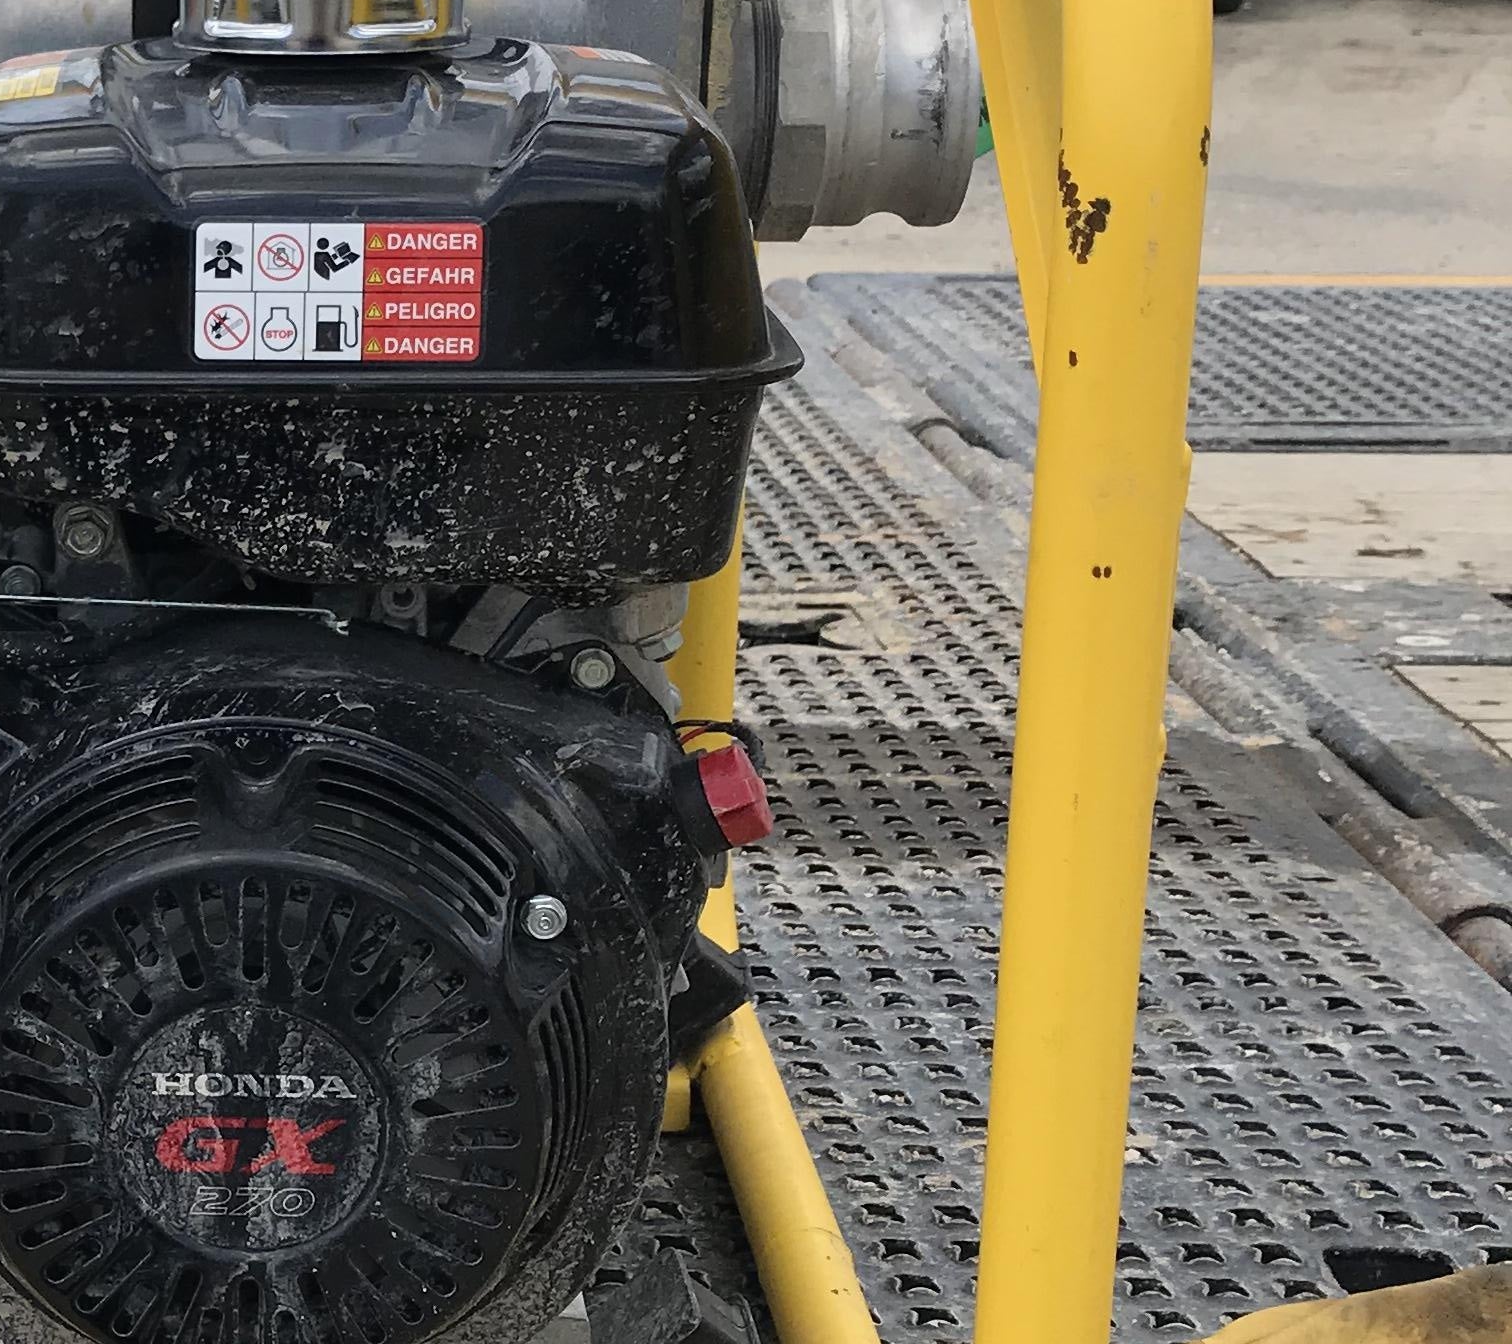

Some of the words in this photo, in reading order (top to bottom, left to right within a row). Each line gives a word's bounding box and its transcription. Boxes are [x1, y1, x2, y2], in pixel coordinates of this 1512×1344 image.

[387, 233, 477, 251] DANGER
[385, 267, 475, 285] GEFAHR
[385, 302, 476, 320] PELIGRO
[265, 330, 294, 339] STOP
[384, 337, 474, 354] DANGER
[151, 1072, 357, 1099] HONDA
[155, 1116, 346, 1175] GX
[190, 1186, 316, 1217] 270
